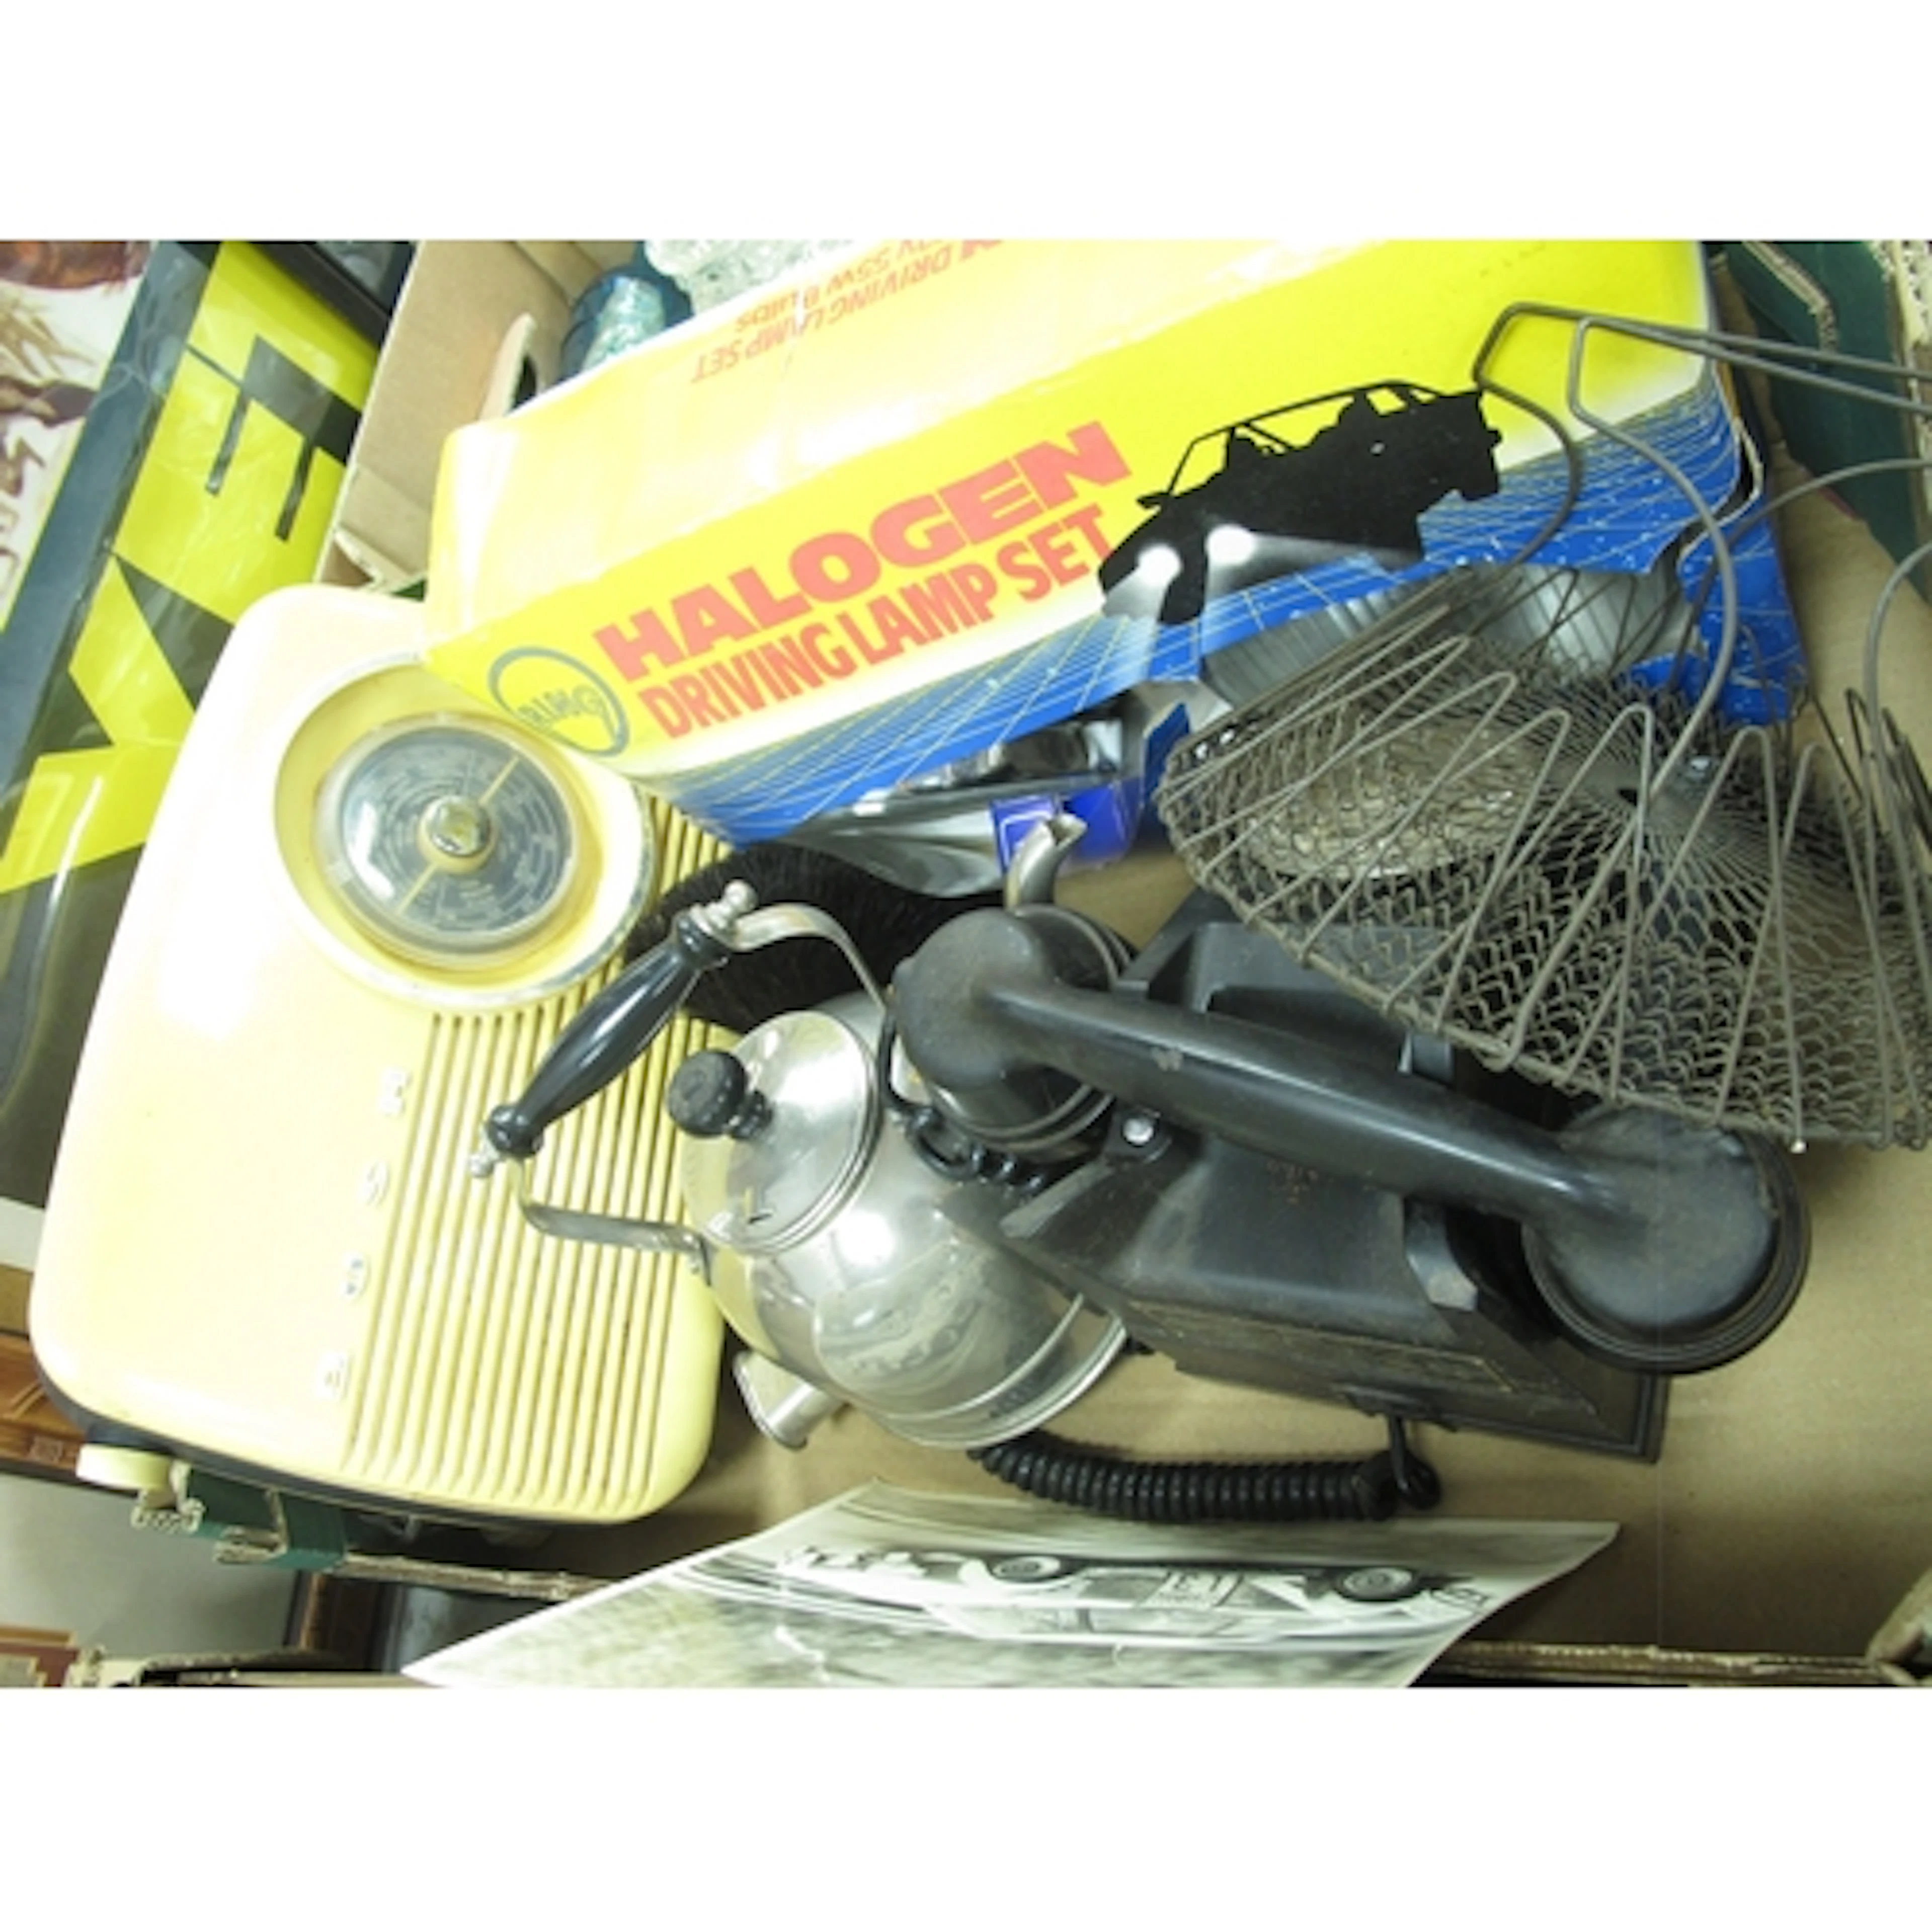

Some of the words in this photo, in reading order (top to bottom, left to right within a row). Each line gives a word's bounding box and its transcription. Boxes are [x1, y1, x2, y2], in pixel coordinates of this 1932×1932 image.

[691, 339, 743, 383] SET
[829, 245, 952, 325] DRIVING
[593, 421, 1132, 682] HALOGEN
[638, 620, 856, 739] DRIVING
[836, 561, 999, 666] LAMP
[995, 503, 1112, 602] SET
